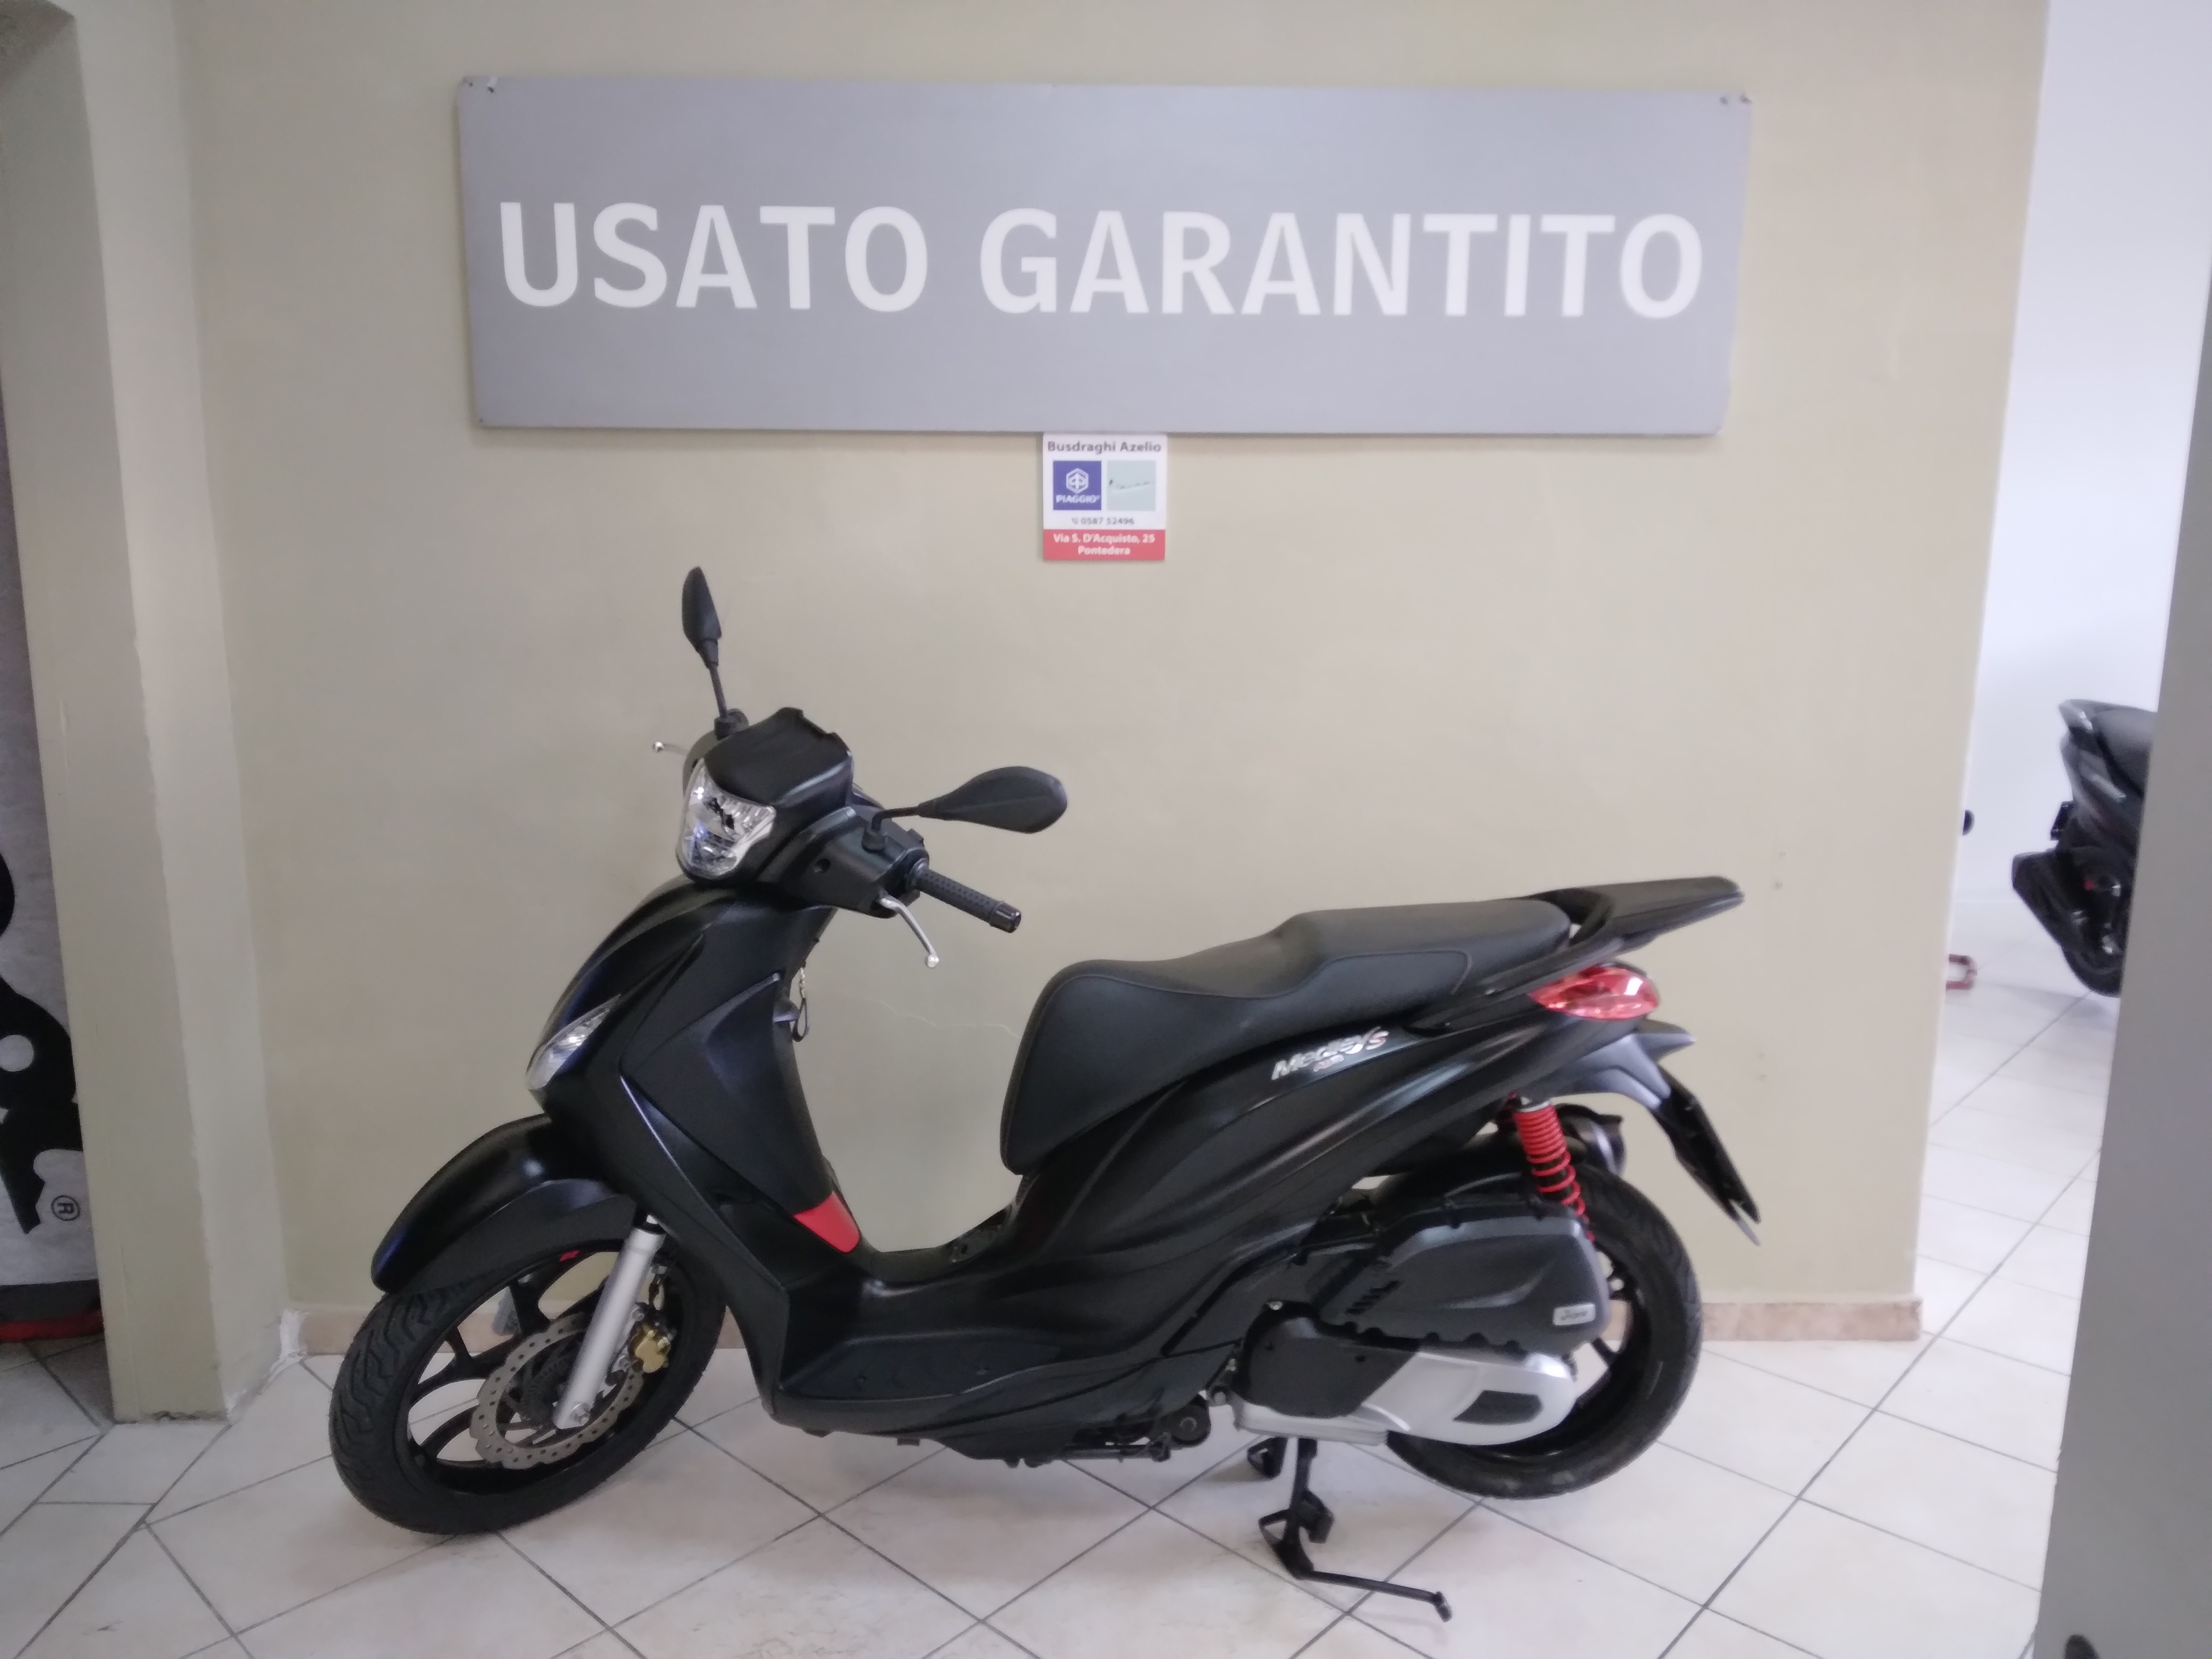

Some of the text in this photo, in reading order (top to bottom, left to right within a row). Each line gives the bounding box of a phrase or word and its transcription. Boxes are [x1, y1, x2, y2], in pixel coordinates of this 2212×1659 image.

[500, 202, 1703, 319] USATO GARANTITO
[1048, 441, 1161, 454] Busdraghi Azelio
[1056, 495, 1097, 503] PIAGGIO
[1053, 533, 1069, 543] Via
[1072, 533, 1081, 543] S.
[1078, 545, 1130, 555] Pontedera
